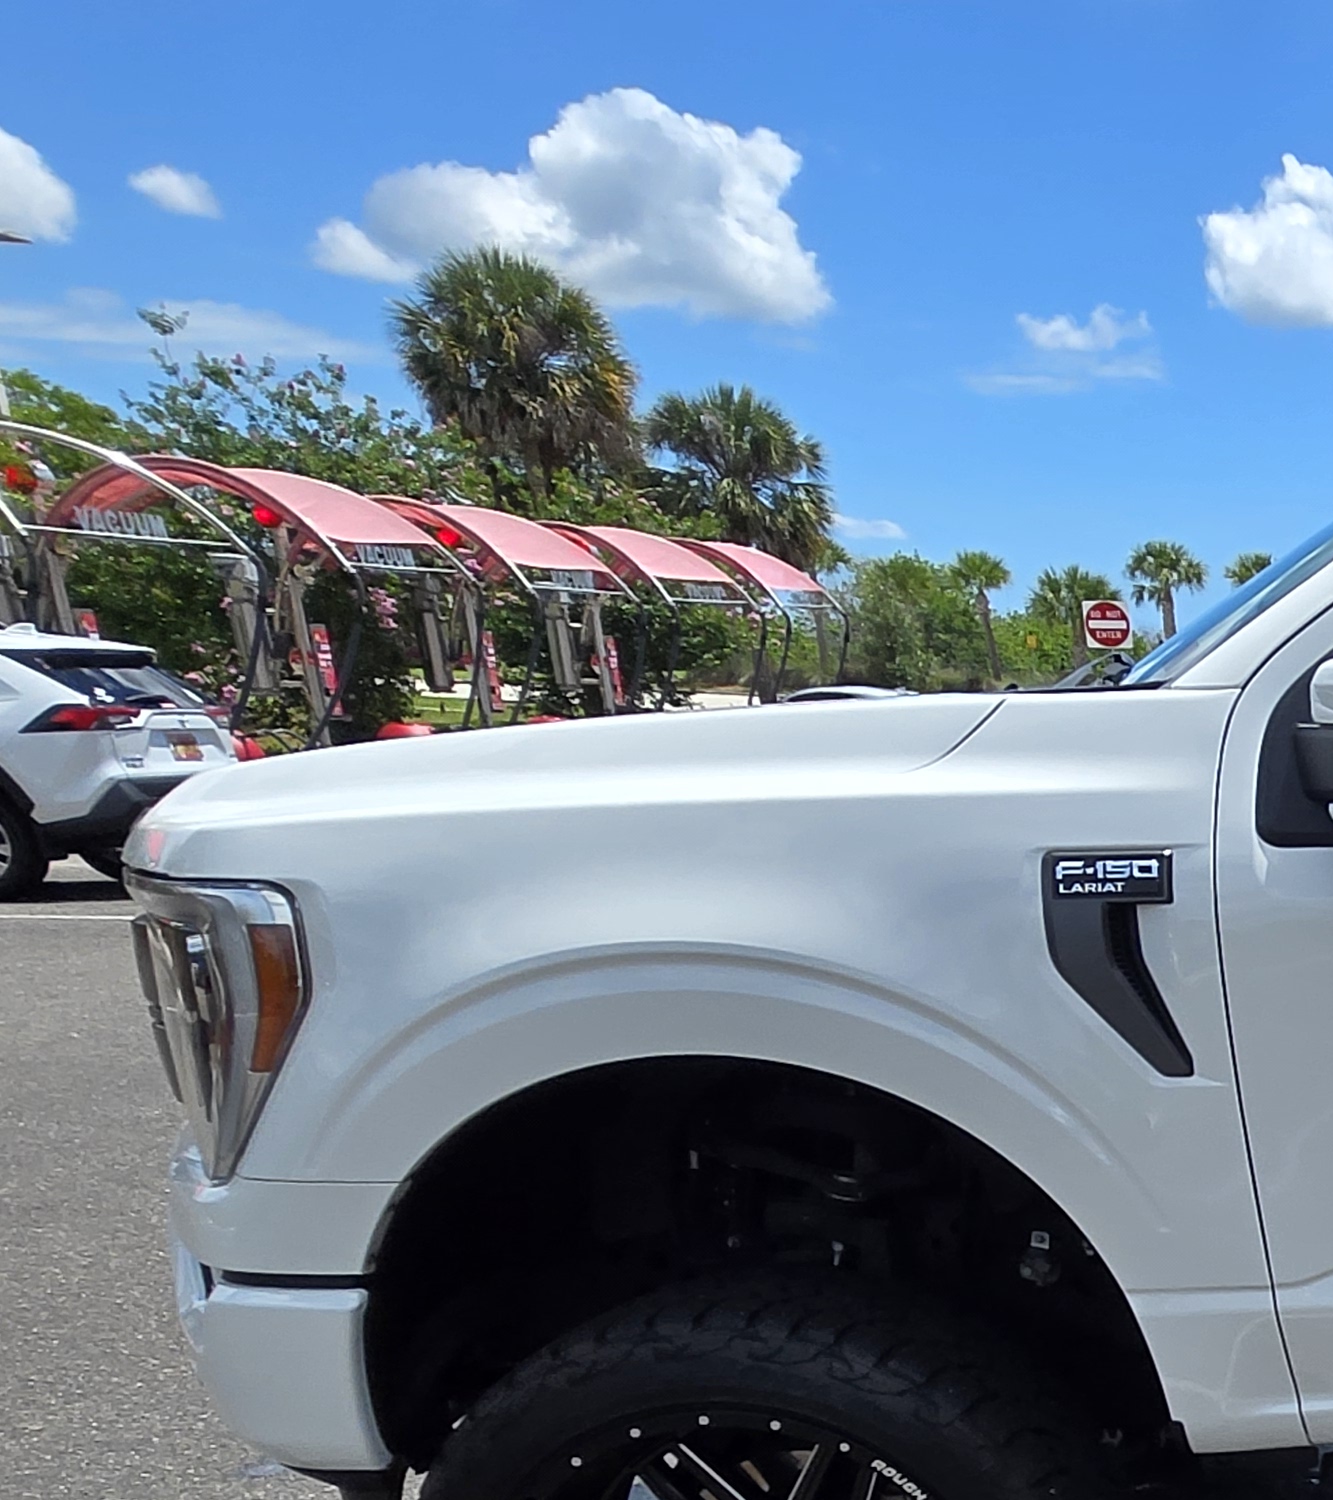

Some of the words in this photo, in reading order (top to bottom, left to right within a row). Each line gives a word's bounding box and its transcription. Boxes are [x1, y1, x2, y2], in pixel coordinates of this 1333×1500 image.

[73, 505, 168, 538] VACUUM
[354, 543, 415, 567] VACUUM
[1090, 610, 1101, 618] DO
[1105, 610, 1121, 618] NOT
[1095, 630, 1122, 639] ENTER
[1055, 859, 1159, 880] F-150
[1058, 882, 1126, 893] LARIAT
